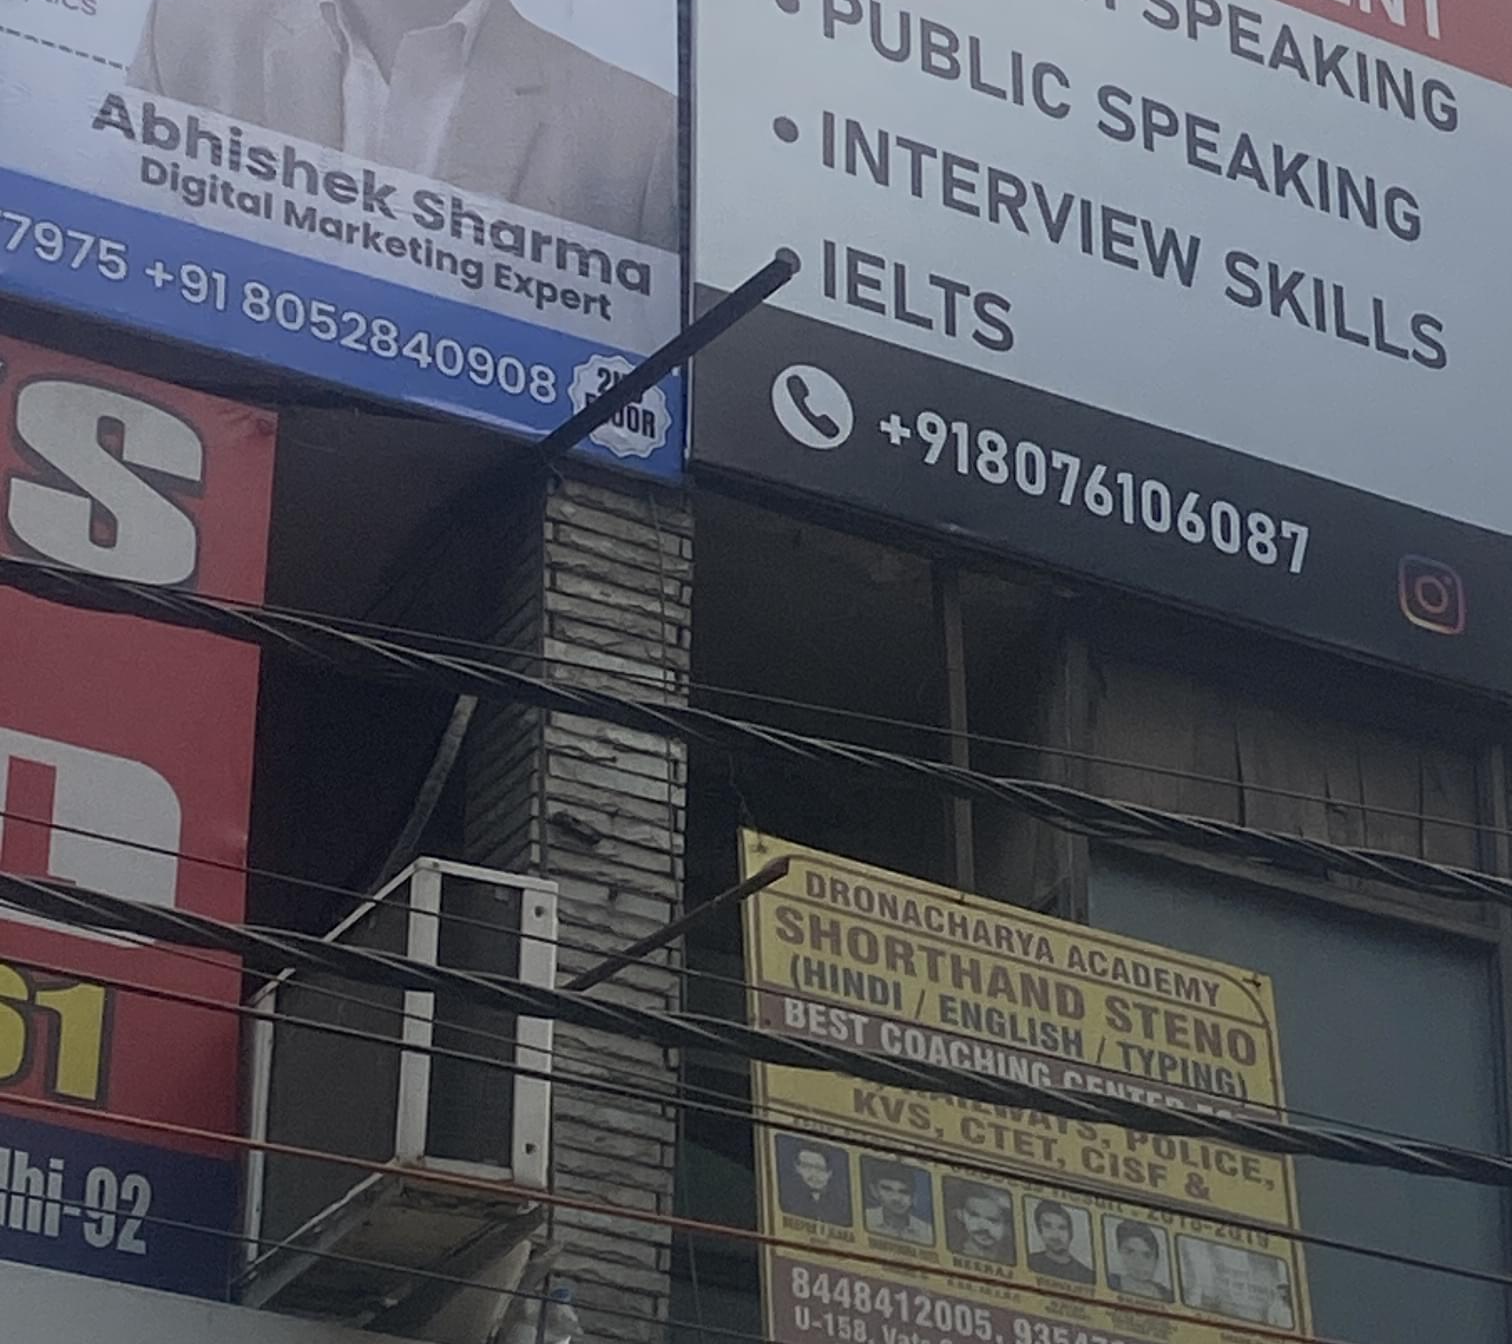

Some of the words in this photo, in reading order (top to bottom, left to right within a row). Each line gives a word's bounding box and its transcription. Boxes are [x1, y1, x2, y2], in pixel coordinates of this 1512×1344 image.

[92, 92, 398, 219] Abhishek
[413, 188, 652, 297] Sharma
[1097, 83, 1422, 244] SPEAKING
[141, 155, 273, 221] Digital
[283, 199, 484, 290] Marketing
[495, 262, 613, 322] Expert
[821, 110, 1201, 289] INTERVIEW
[1225, 250, 1448, 371] SKILLS
[822, 238, 1015, 353] IELTS
[145, 259, 228, 313] +91
[242, 280, 558, 404] 8052840908
[880, 410, 1309, 574] +918076106087
[775, 906, 1085, 1021] SHORTHAND
[1105, 993, 1257, 1068] STENO
[805, 869, 1055, 965] DRONACHARYA
[1068, 944, 1220, 1008] ACADEMY
[784, 996, 870, 1046] BEST
[880, 1020, 1051, 1089] COACHING
[789, 954, 901, 1011] (HINDI
[938, 991, 1083, 1062] ENGLISH
[1116, 1039, 1248, 1103] TYPING)
[853, 1088, 945, 1139] KVS,
[960, 1115, 1067, 1171] CTET,
[1081, 1145, 1168, 1189] CISF
[1184, 1171, 1211, 1202] &
[1127, 1127, 1276, 1192] POLICE,
